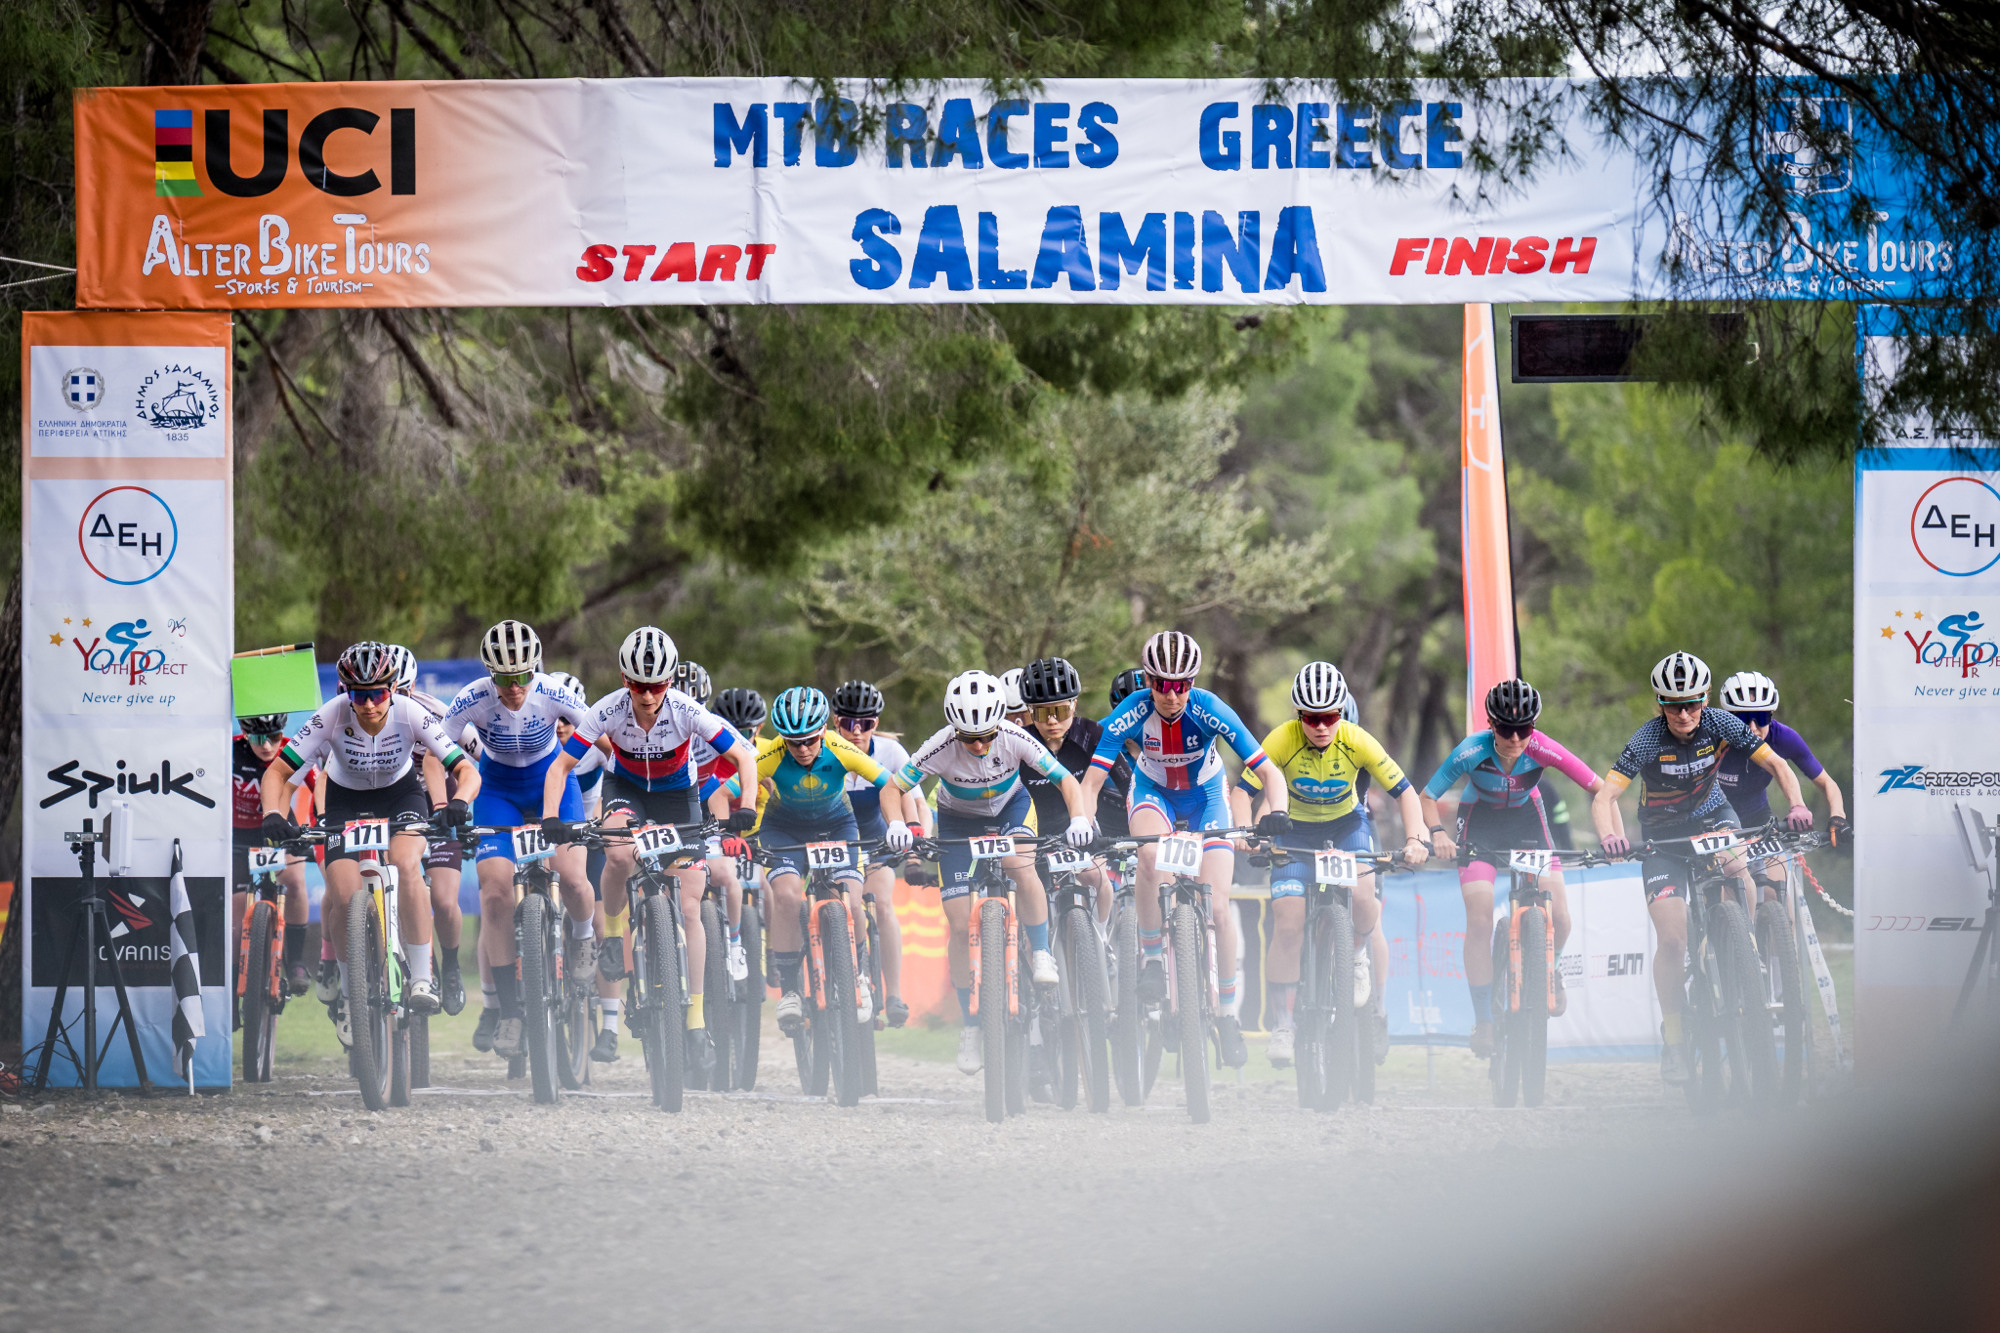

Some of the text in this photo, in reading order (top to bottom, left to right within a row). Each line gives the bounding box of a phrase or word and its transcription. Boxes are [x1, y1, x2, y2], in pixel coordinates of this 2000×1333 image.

[713, 97, 1463, 171] MTB RACES GREECE
[204, 107, 416, 197] UCI
[142, 213, 430, 276] ALTER BIKE TOURS
[850, 205, 1327, 293] SALAMINA
[1781, 211, 1859, 273] BIKE
[1860, 210, 1954, 273] TOURS
[576, 242, 776, 282] START
[1389, 237, 1597, 276] FINISH
[287, 277, 298, 294] &
[38, 420, 127, 428] ΕΛΛΗΝΙΚΗ ΔΗΜΟΚΡΑΤΙΑ
[166, 433, 189, 441] 1835
[535, 682, 557, 696] ALTER
[1914, 685, 1955, 696] Never
[1959, 685, 1987, 700] give
[82, 692, 176, 706] Never give up
[455, 697, 472, 709] BIKE
[468, 688, 489, 700] TOURS
[671, 700, 701, 717] GAPP
[1108, 701, 1149, 736] sazka
[345, 748, 371, 757] SEATTLE
[372, 749, 394, 757] COFFEE
[954, 767, 1015, 784] QAZAQSTAN
[1675, 762, 1707, 773] MENTE
[351, 825, 383, 846] 171
[516, 830, 550, 856] 178
[638, 828, 676, 851] 173
[1697, 836, 1731, 851] 177
[974, 839, 1011, 854] 175
[1162, 839, 1197, 866] 176
[256, 852, 279, 867] 62
[811, 847, 845, 864] 179
[1515, 853, 1545, 869] 211
[1319, 856, 1351, 879] 181
[1272, 883, 1303, 893] KMC
[1647, 874, 1669, 885] MAVIC
